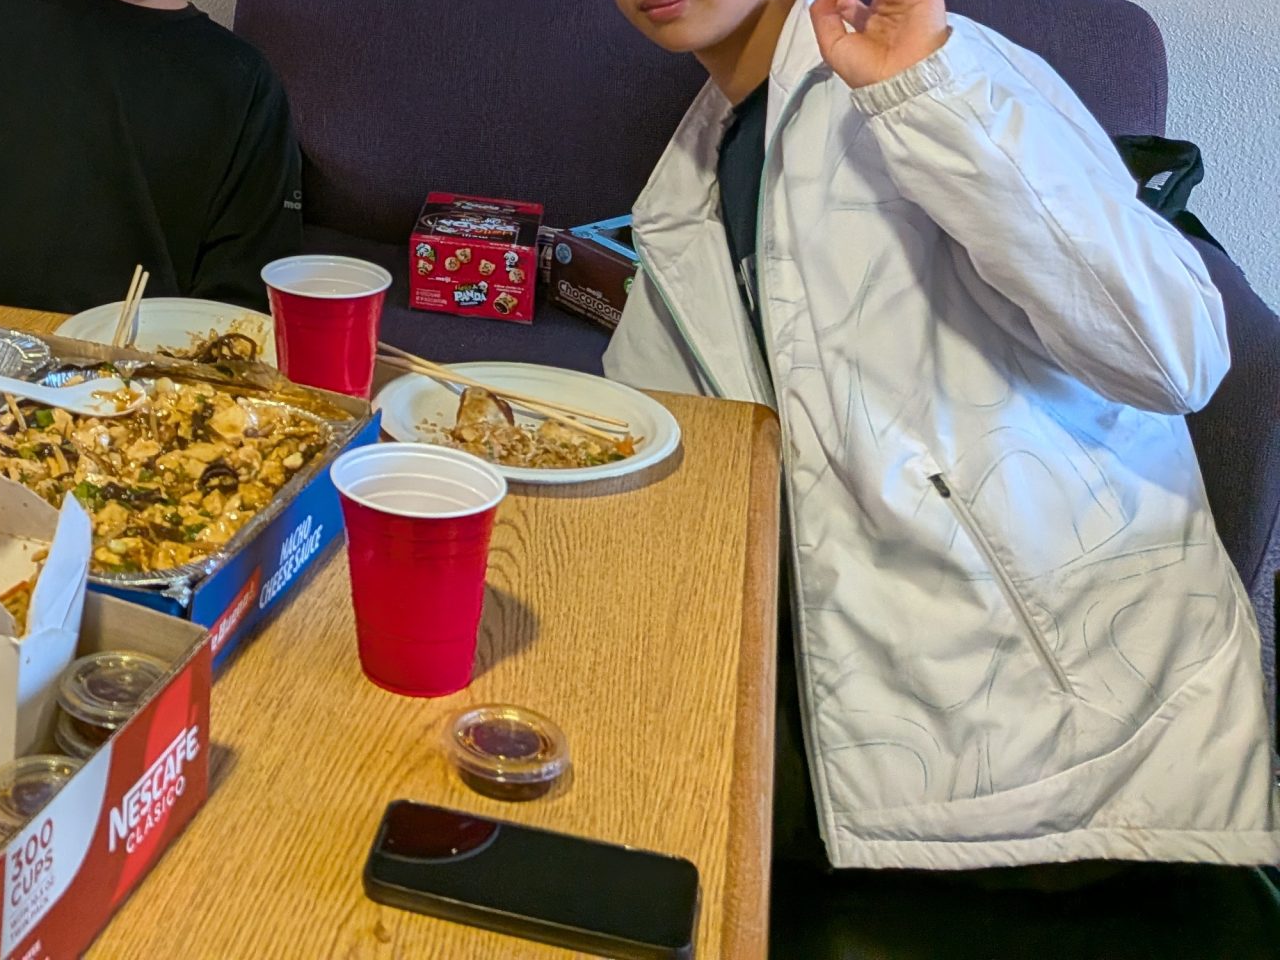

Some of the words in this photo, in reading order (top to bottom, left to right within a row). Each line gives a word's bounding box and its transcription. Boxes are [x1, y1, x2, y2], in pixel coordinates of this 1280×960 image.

[454, 289, 487, 302] PANDA
[558, 280, 622, 321] Chocoroom
[259, 556, 294, 609] CHEESE
[293, 524, 323, 574] SAUCE
[279, 515, 312, 566] NACHO
[11, 818, 54, 882] 300
[11, 848, 54, 907] CUPS
